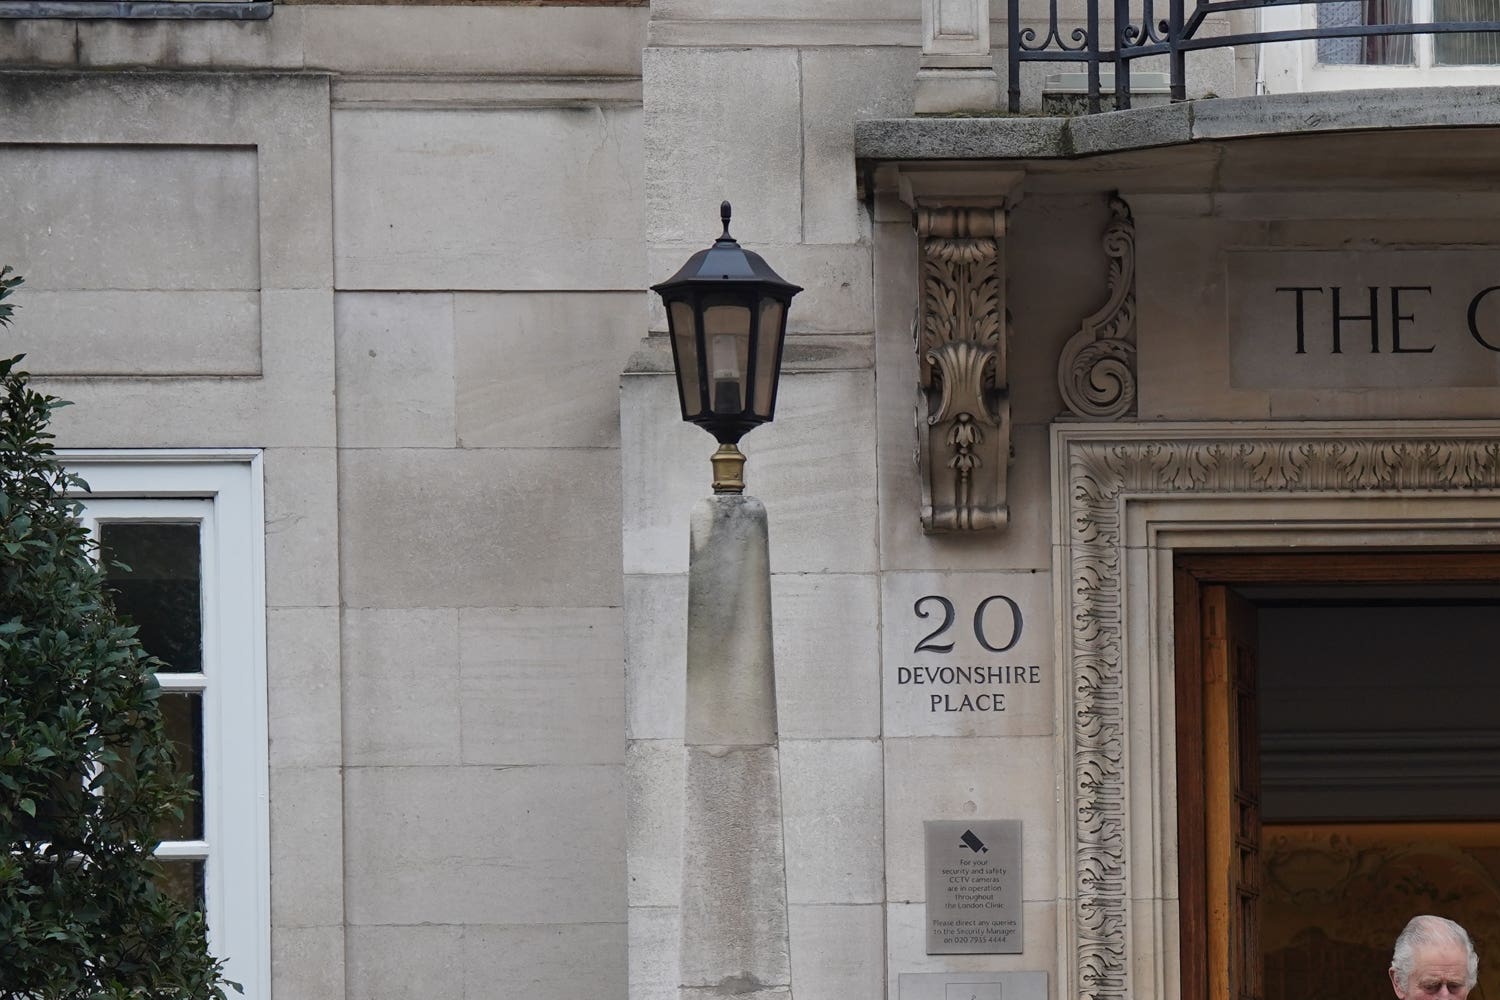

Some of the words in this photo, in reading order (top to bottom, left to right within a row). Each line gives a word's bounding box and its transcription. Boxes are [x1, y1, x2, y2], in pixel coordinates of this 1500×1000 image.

[1275, 286, 1436, 354] THE
[914, 595, 1024, 654] 20
[898, 666, 1041, 684] DEVONSHIRE
[930, 694, 1006, 712] PLACE
